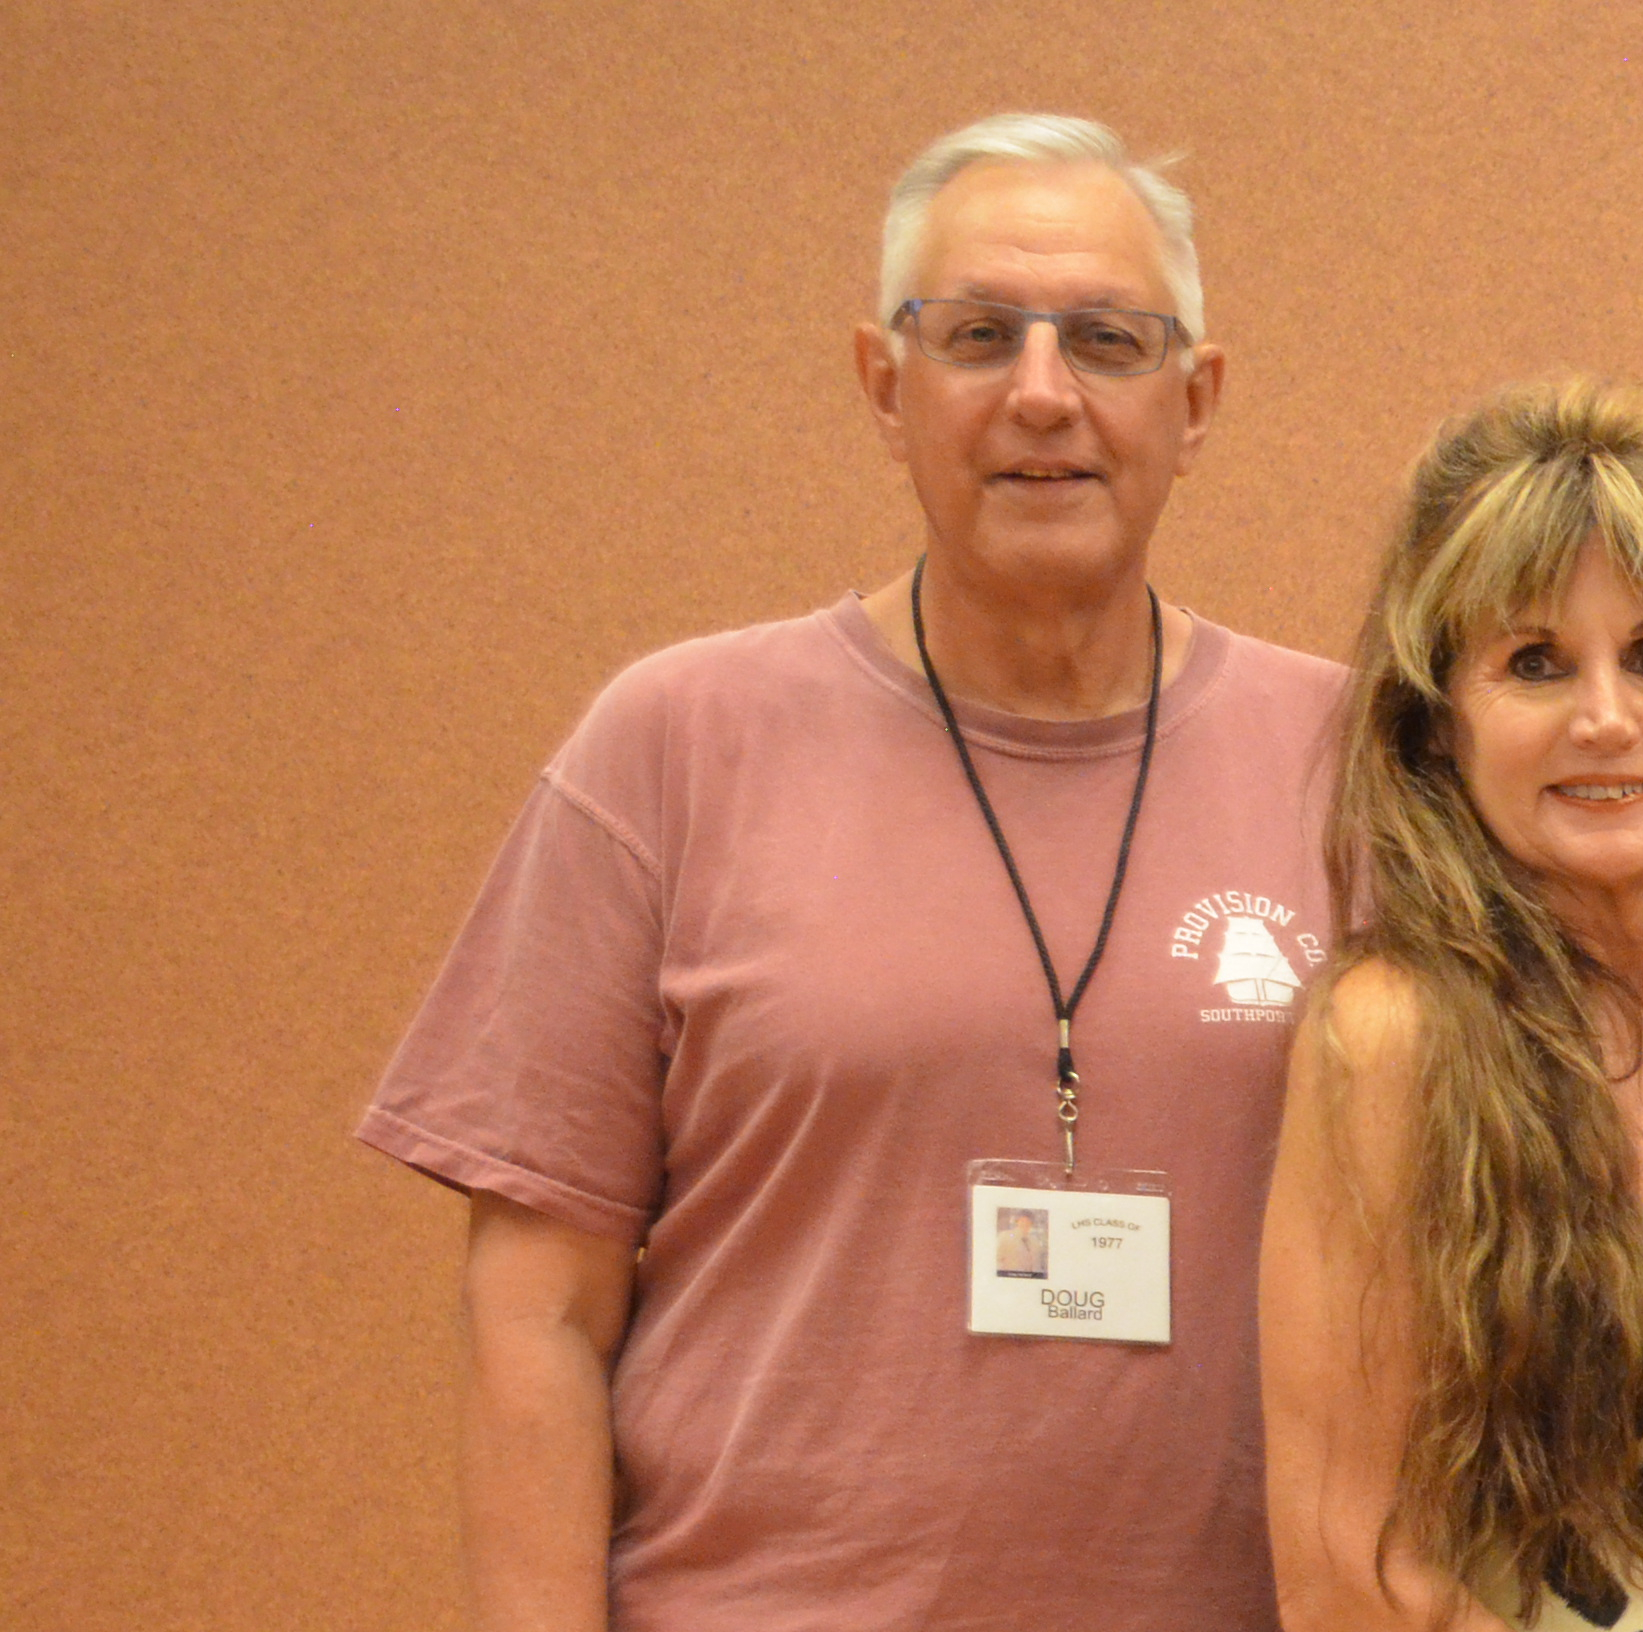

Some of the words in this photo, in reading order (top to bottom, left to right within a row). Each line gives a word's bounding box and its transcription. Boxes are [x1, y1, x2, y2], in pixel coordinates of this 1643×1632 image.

[1171, 890, 1296, 960] PROVISION
[1093, 1217, 1126, 1229] CLASS
[1091, 1236, 1124, 1250] 1977
[1040, 1288, 1106, 1309] DOUG
[1047, 1303, 1103, 1321] Ballard
